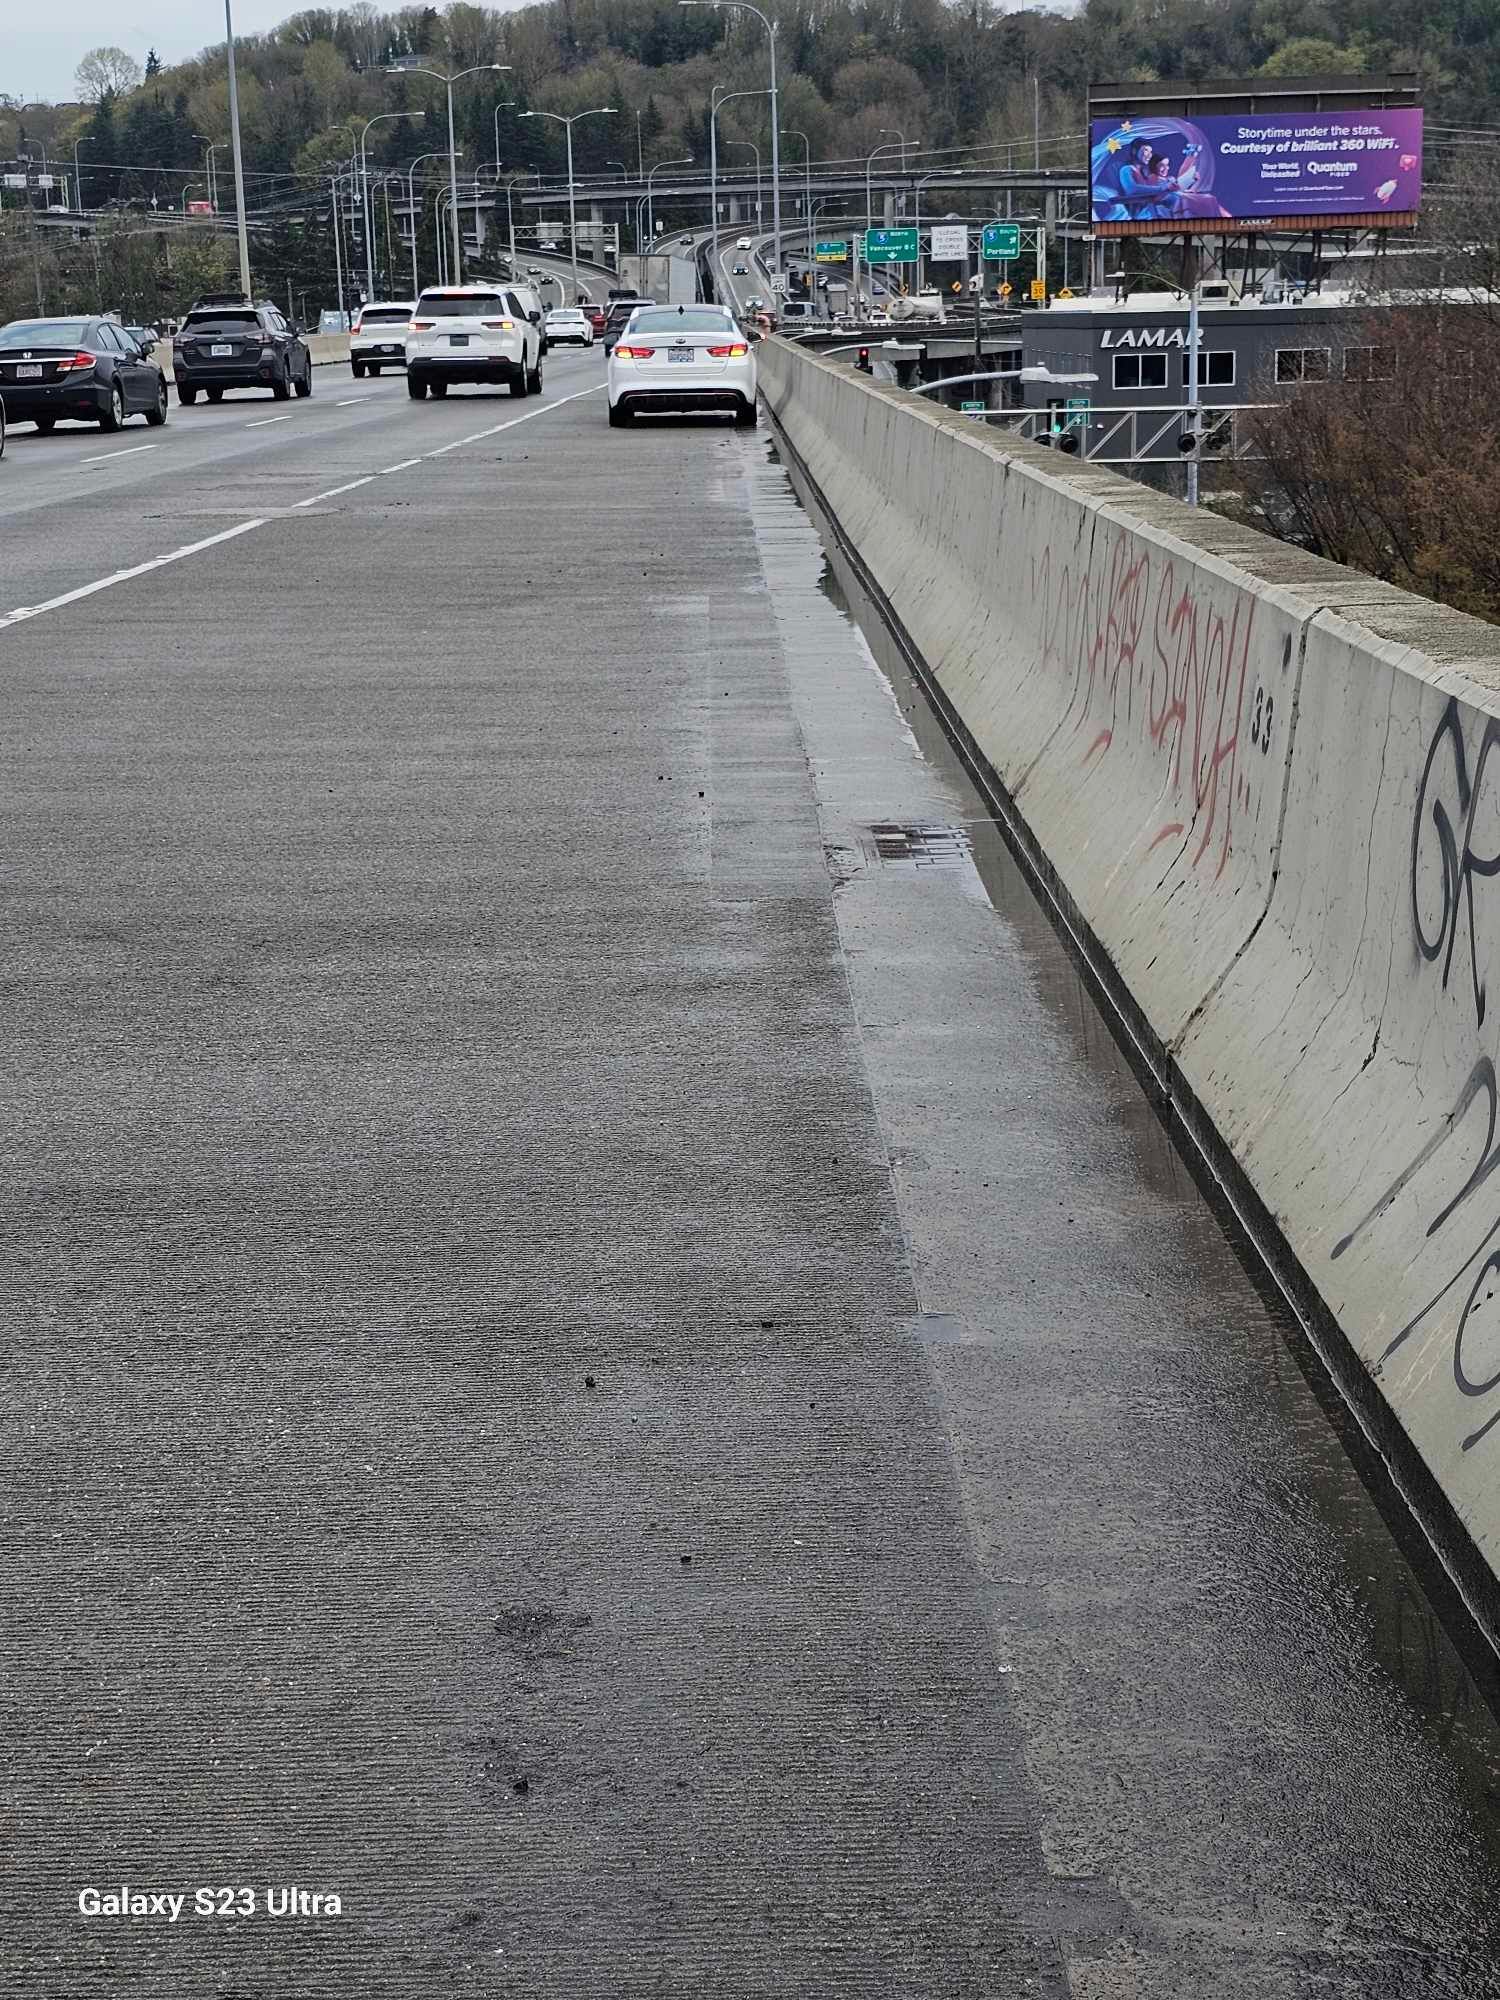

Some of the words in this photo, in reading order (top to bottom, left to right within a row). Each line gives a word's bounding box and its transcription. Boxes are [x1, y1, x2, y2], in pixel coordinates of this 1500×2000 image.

[1237, 127, 1293, 140] Storytime
[1294, 126, 1329, 137] under
[1331, 125, 1350, 136] the
[1351, 125, 1383, 136] stars.
[1220, 142, 1274, 155] Courtesy
[1275, 140, 1290, 153] of
[1291, 139, 1339, 152] brilliant
[1339, 139, 1365, 151] 360
[1306, 161, 1358, 175] Quantum
[1100, 327, 1205, 349] LAMAR
[1251, 686, 1274, 756] 33
